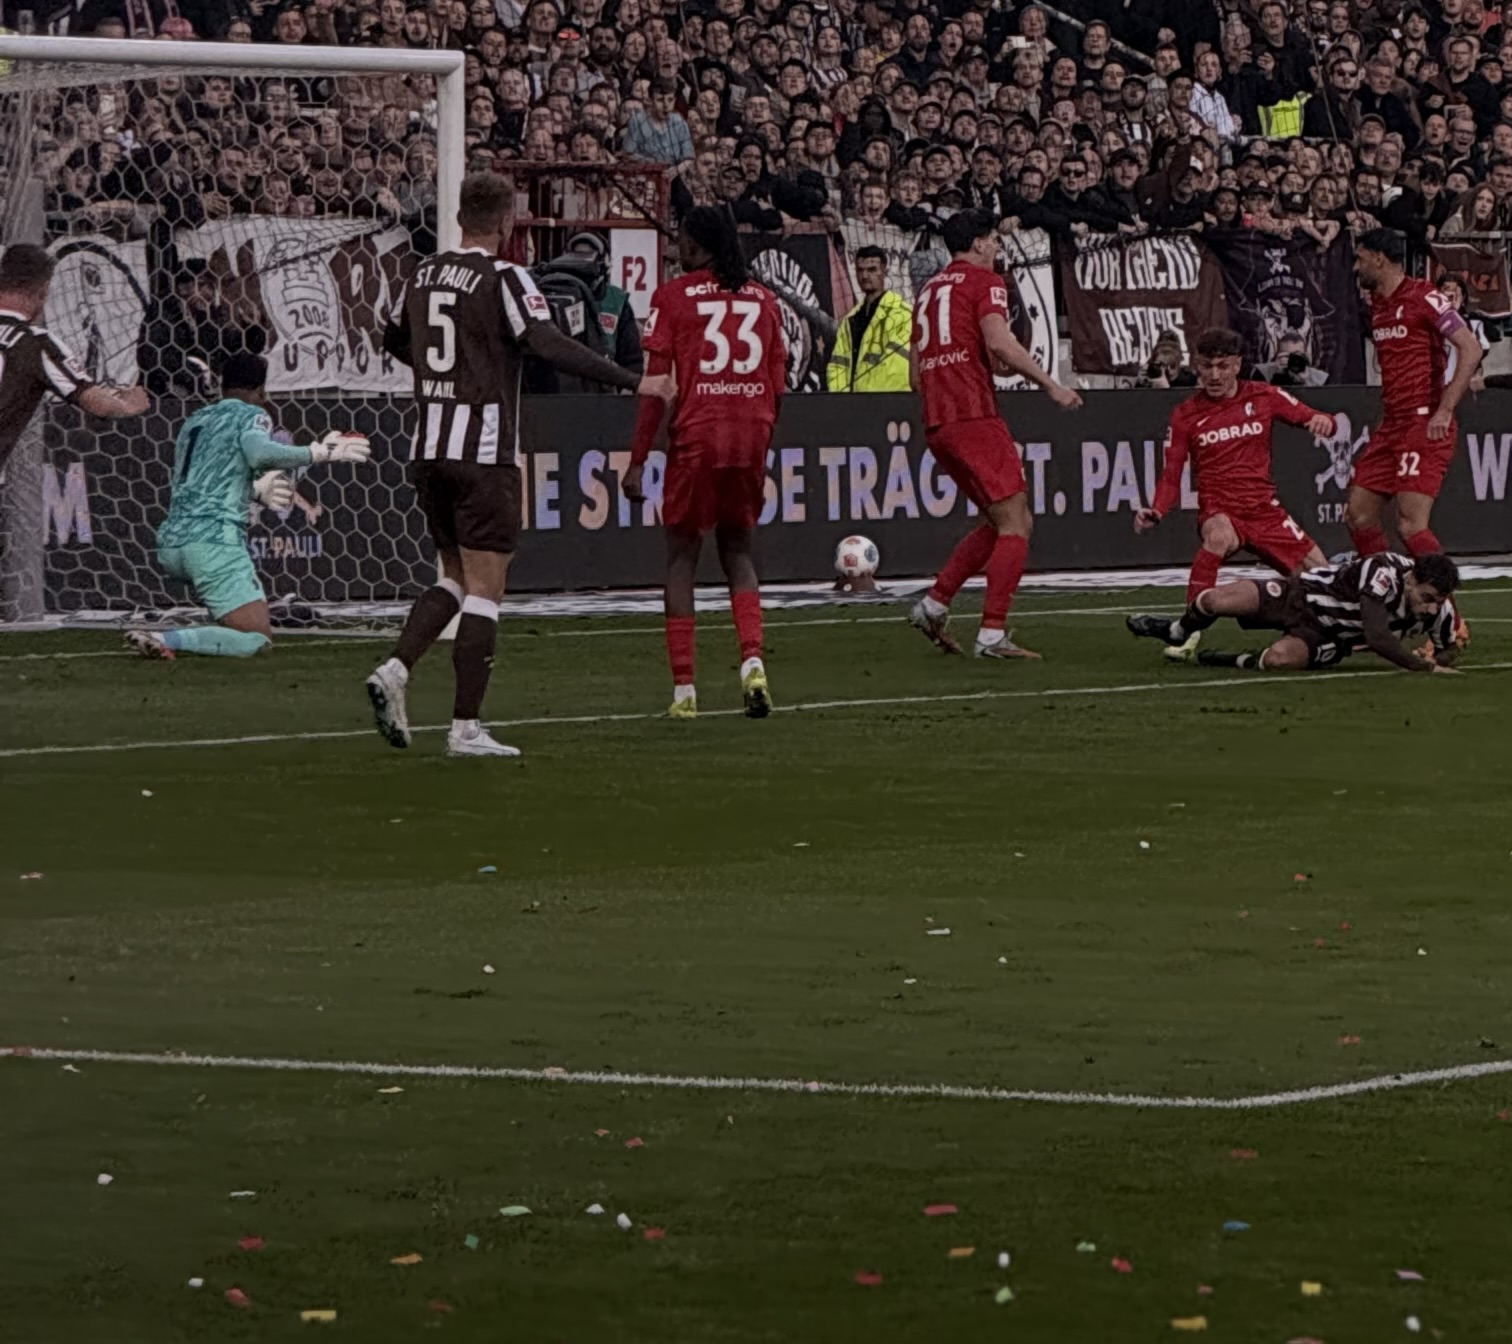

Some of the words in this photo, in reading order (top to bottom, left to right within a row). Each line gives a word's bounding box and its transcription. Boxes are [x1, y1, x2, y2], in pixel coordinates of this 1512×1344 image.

[436, 264, 482, 295] PAULI
[622, 256, 647, 291] F2
[427, 291, 456, 373] 5
[916, 284, 953, 353] 31
[696, 299, 763, 375] 33
[422, 379, 456, 399] WAHL
[697, 379, 765, 398] makengo
[1198, 421, 1264, 447] JOBRAD
[819, 420, 980, 521] TRÄG
[1396, 452, 1421, 477] 32
